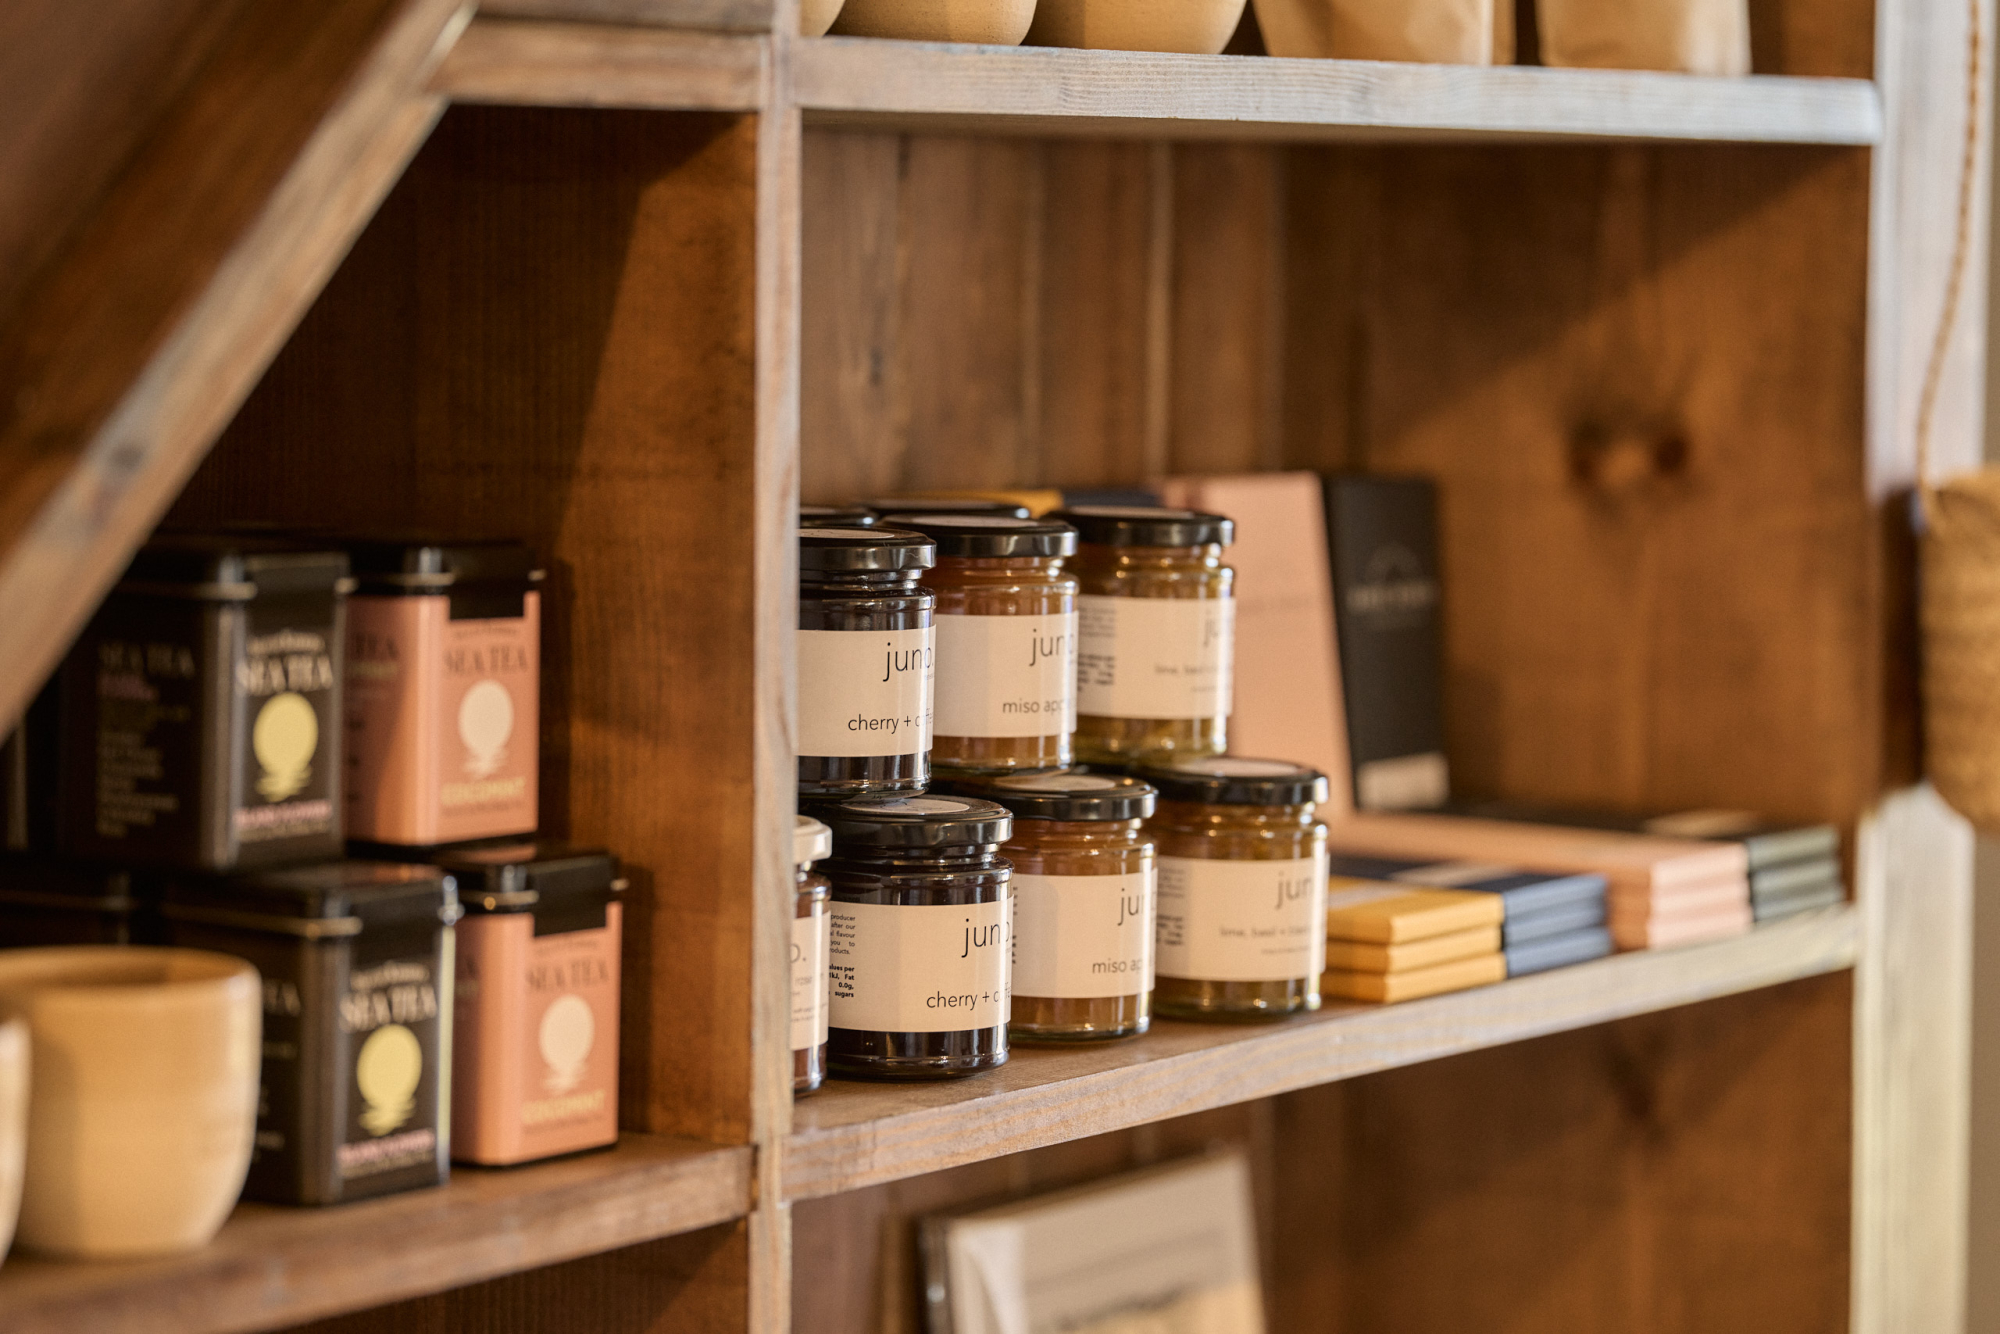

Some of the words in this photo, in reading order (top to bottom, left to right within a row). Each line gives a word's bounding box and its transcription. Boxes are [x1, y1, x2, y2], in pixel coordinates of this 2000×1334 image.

[444, 646, 486, 676] SEA
[488, 645, 528, 673] TEA
[236, 655, 287, 697] SEA
[285, 653, 334, 692] TEA
[1003, 697, 1040, 713] miso
[848, 713, 899, 734] cherry
[903, 715, 911, 727] +
[525, 965, 566, 992] SEA
[570, 957, 609, 988] TEA
[1092, 958, 1127, 974] miso
[339, 991, 391, 1032] SEA
[389, 984, 437, 1023] TEA
[926, 991, 978, 1012] cherry
[982, 991, 990, 1003] +
